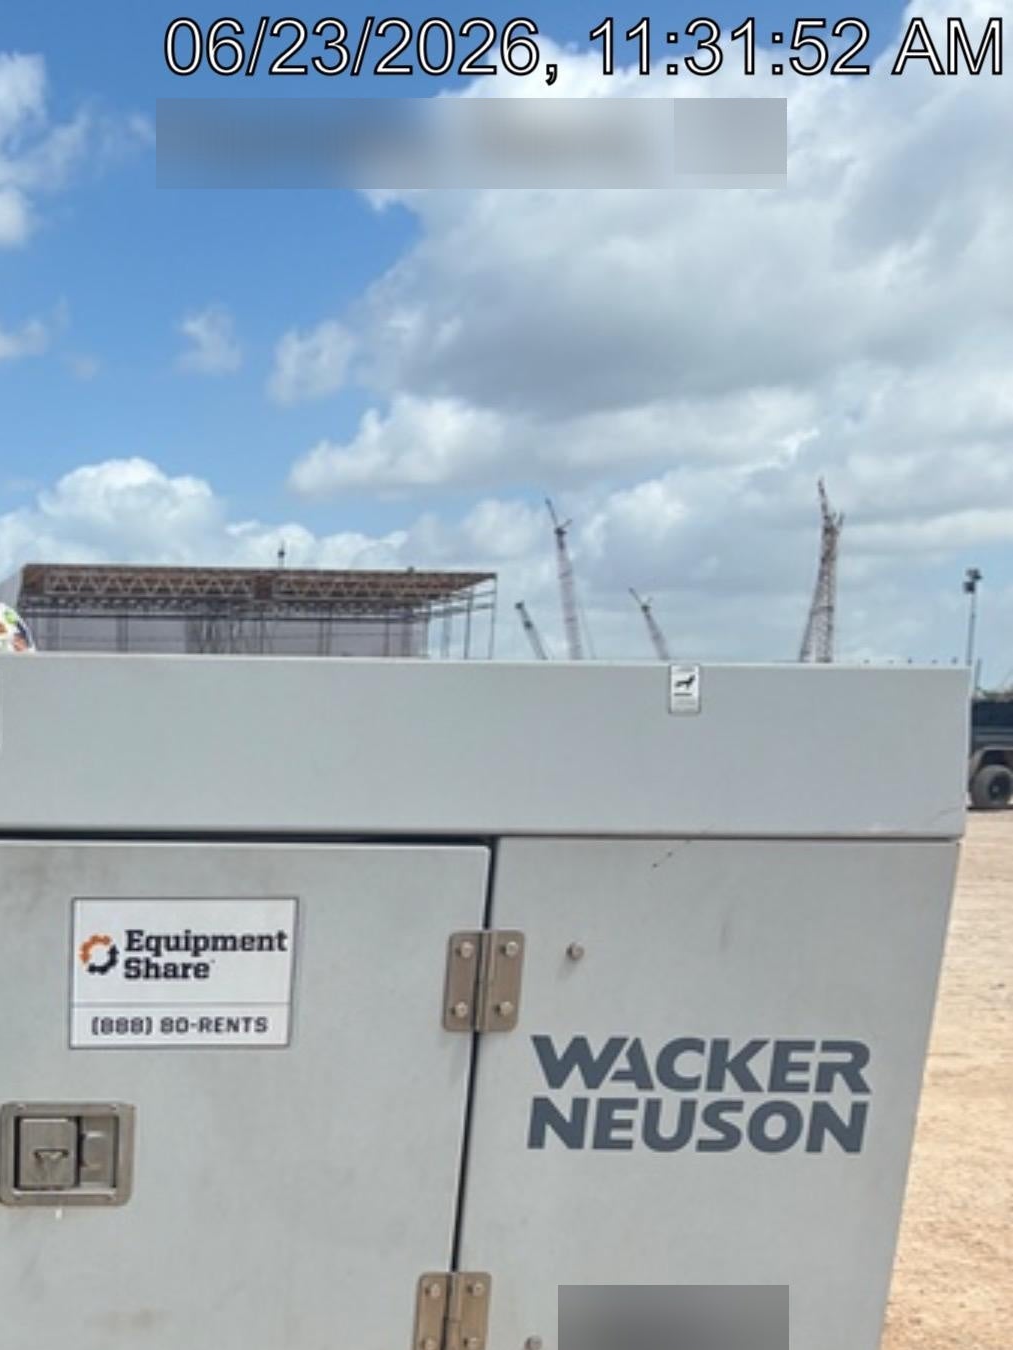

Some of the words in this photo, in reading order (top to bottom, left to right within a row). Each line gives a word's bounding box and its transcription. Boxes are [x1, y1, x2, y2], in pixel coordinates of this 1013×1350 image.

[124, 928, 288, 957] Equipment
[124, 956, 210, 980] Share
[91, 1016, 152, 1036] (888)
[160, 1016, 269, 1034] 80-RENTS
[530, 1034, 873, 1095] WACKER
[527, 1097, 869, 1154] NEUSON
